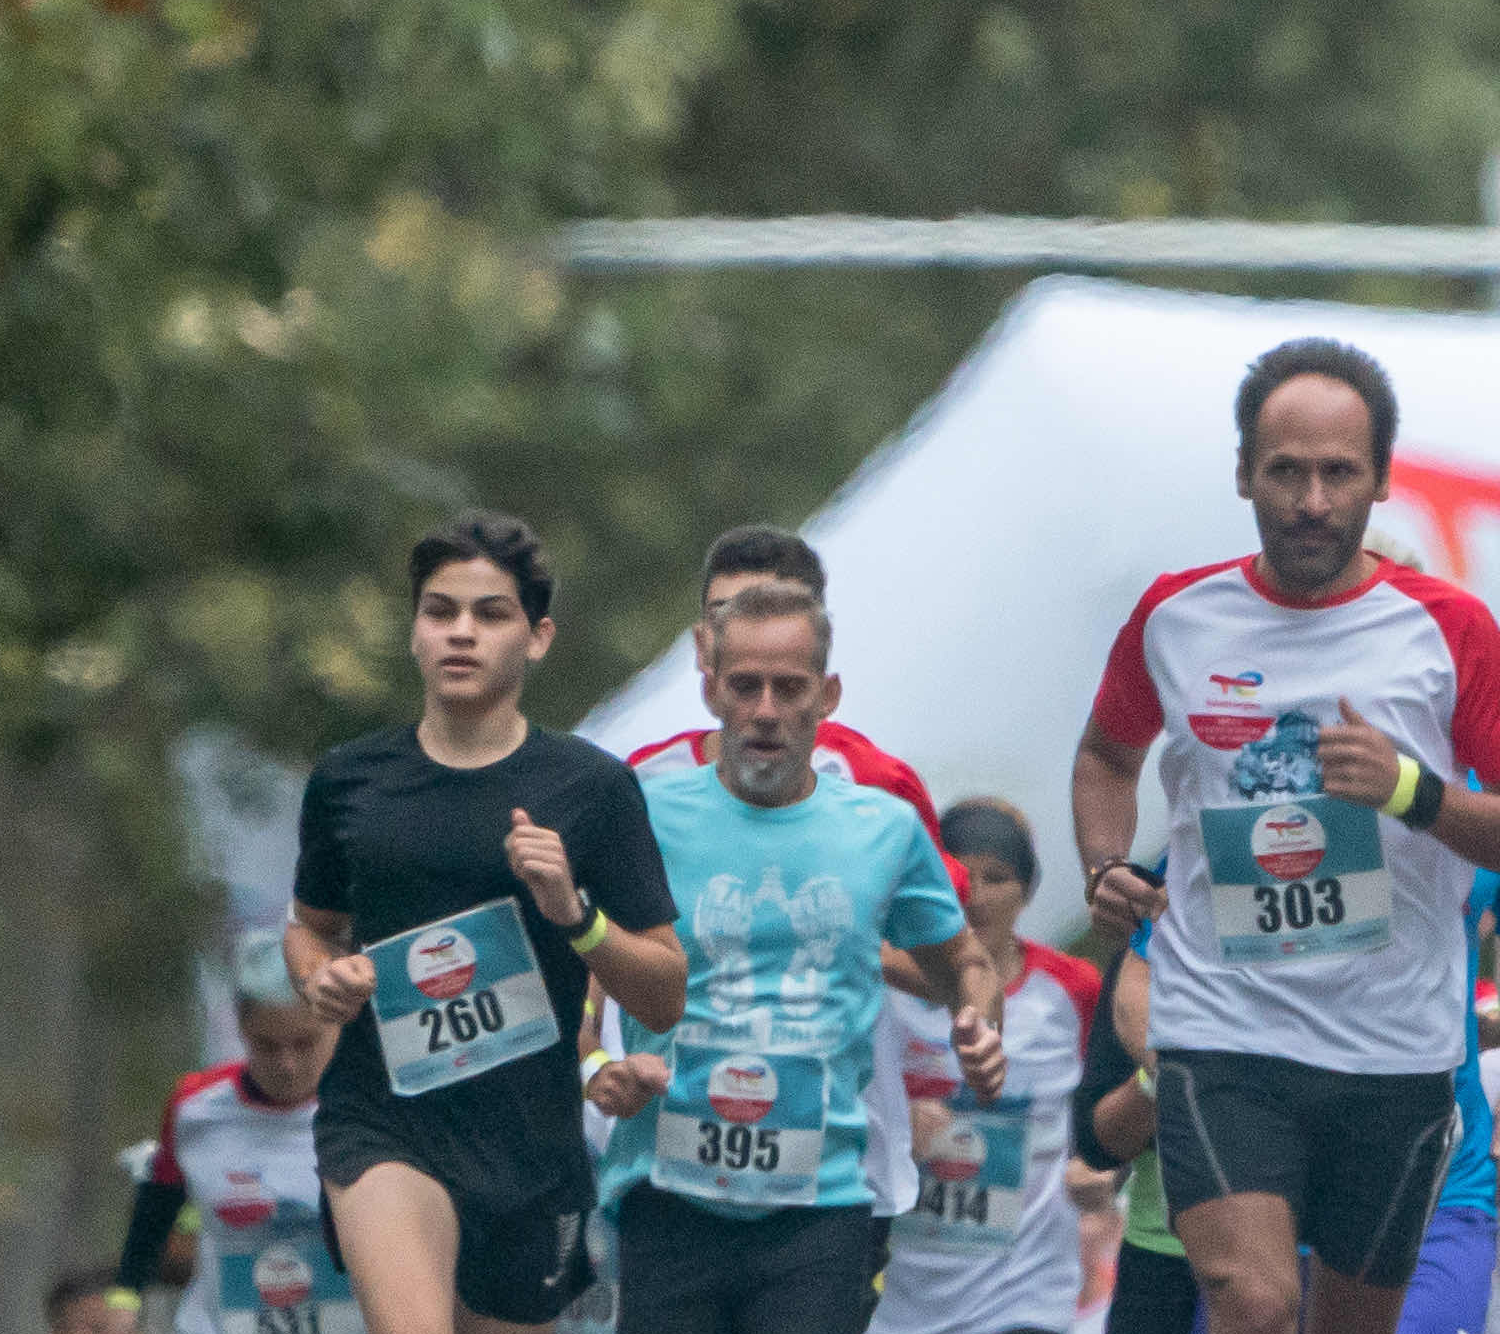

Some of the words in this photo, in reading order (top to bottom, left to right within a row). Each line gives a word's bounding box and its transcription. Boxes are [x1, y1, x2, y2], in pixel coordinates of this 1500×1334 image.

[1254, 877, 1345, 933] 303
[419, 989, 505, 1054] 260
[697, 1122, 780, 1171] 395
